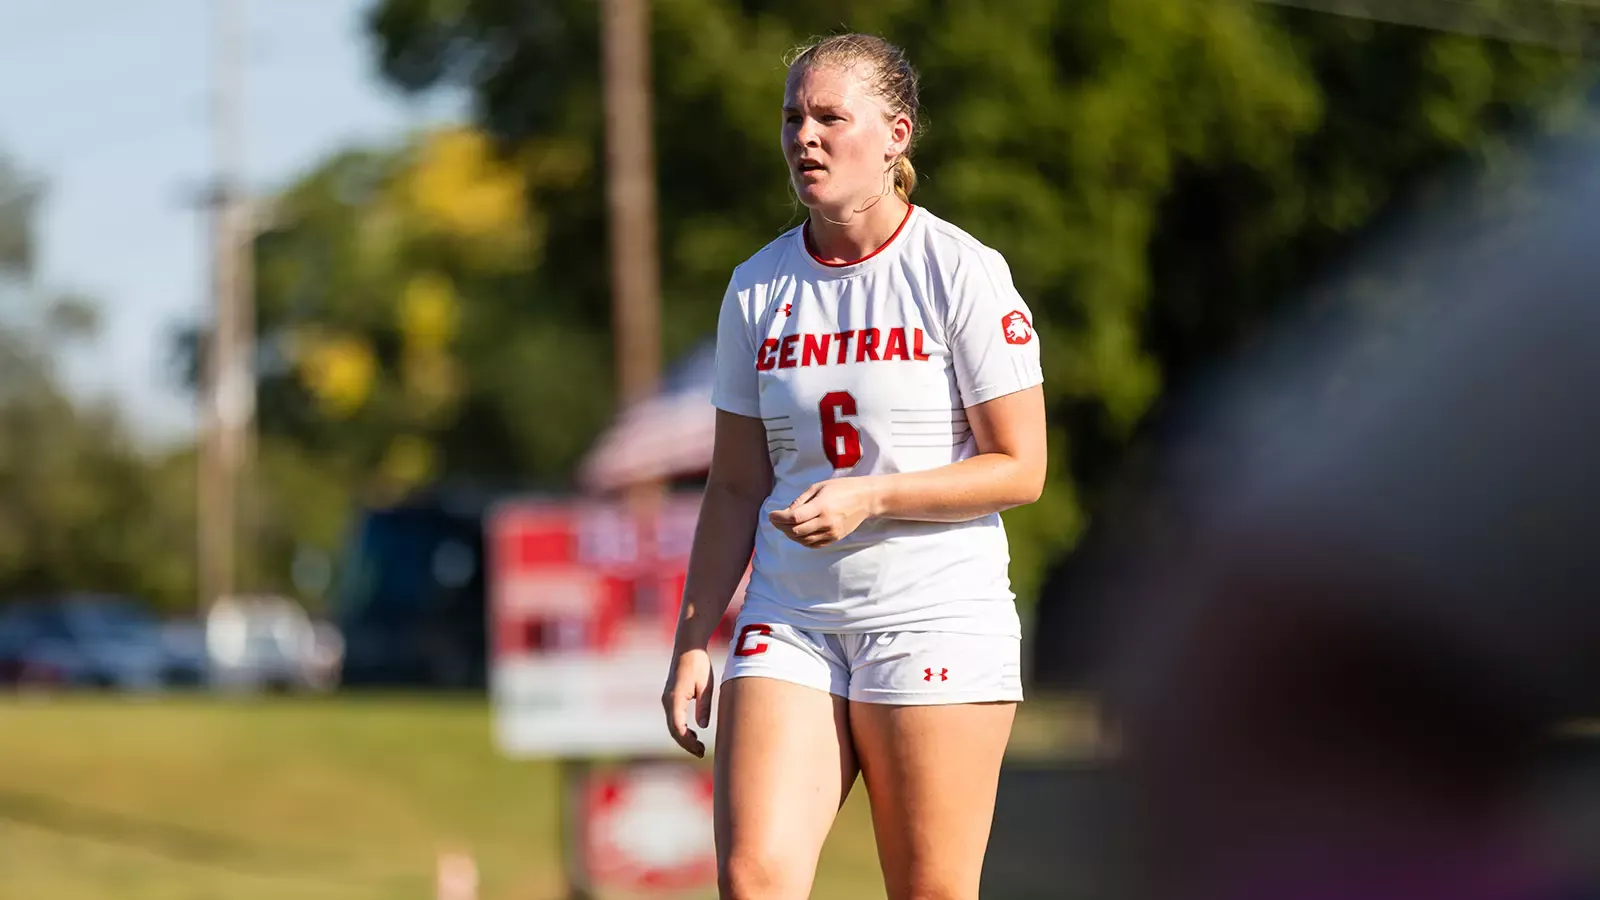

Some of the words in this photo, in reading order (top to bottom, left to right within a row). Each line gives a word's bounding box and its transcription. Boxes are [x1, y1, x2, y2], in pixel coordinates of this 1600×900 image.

[756, 327, 930, 371] CENTRAL
[818, 391, 862, 469] 6
[734, 623, 771, 656] C
